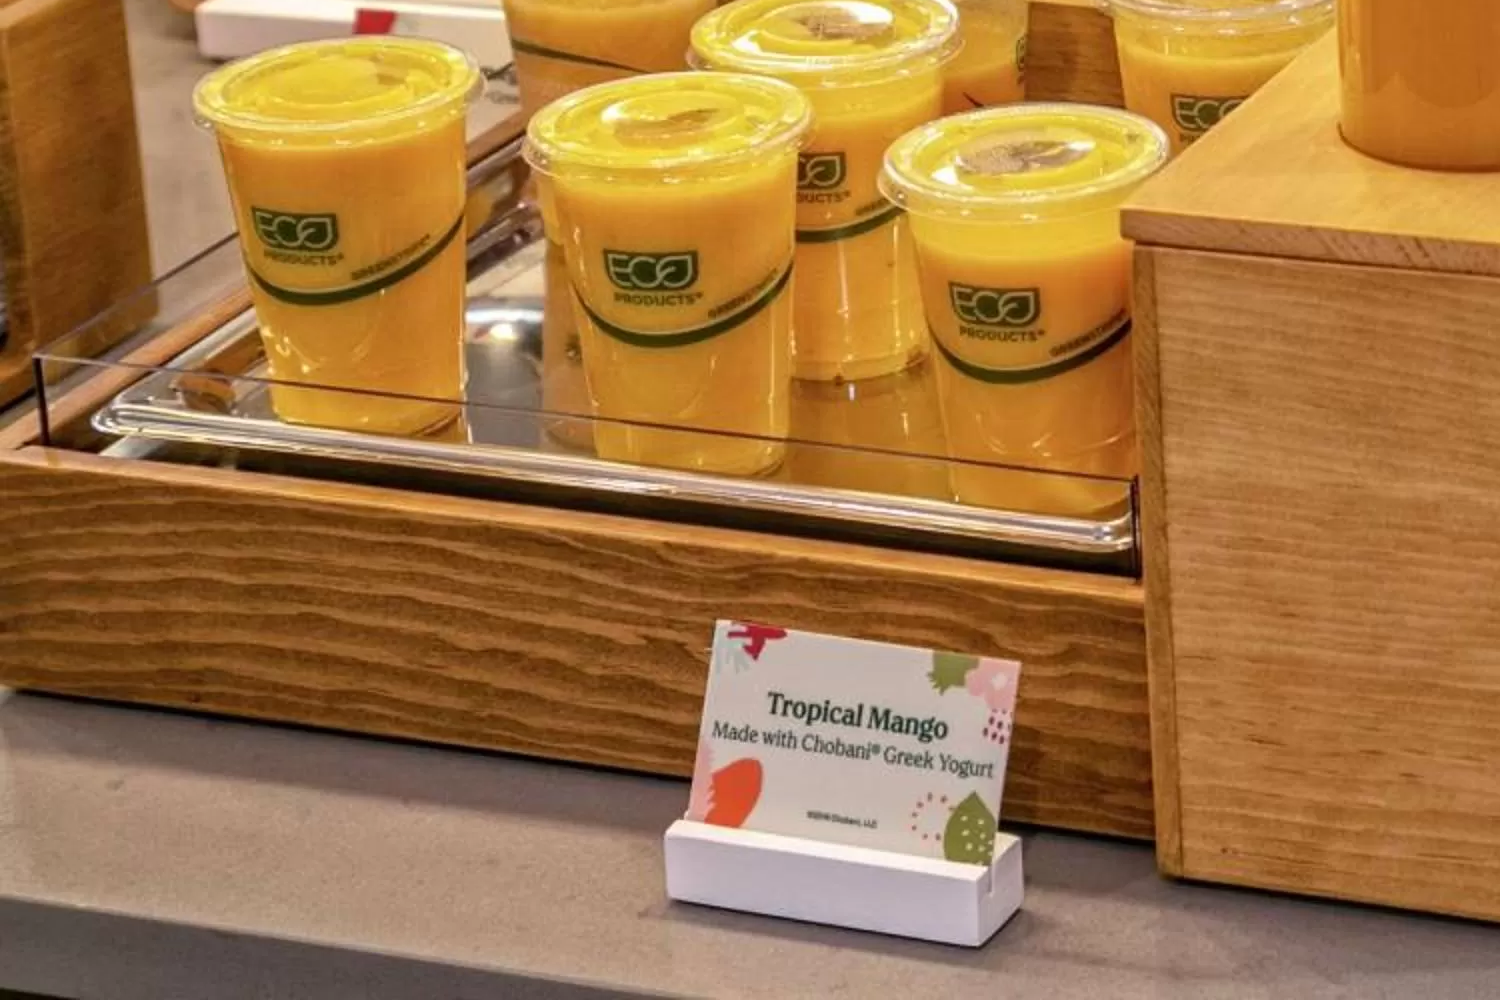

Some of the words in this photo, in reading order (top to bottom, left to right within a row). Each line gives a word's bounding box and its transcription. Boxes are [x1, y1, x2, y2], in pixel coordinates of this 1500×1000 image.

[767, 690, 865, 728] Tropical
[866, 705, 950, 744] Mango
[711, 719, 759, 744] Made
[762, 727, 798, 751] with
[882, 745, 934, 770] Greek
[938, 753, 995, 780] Yogurt
